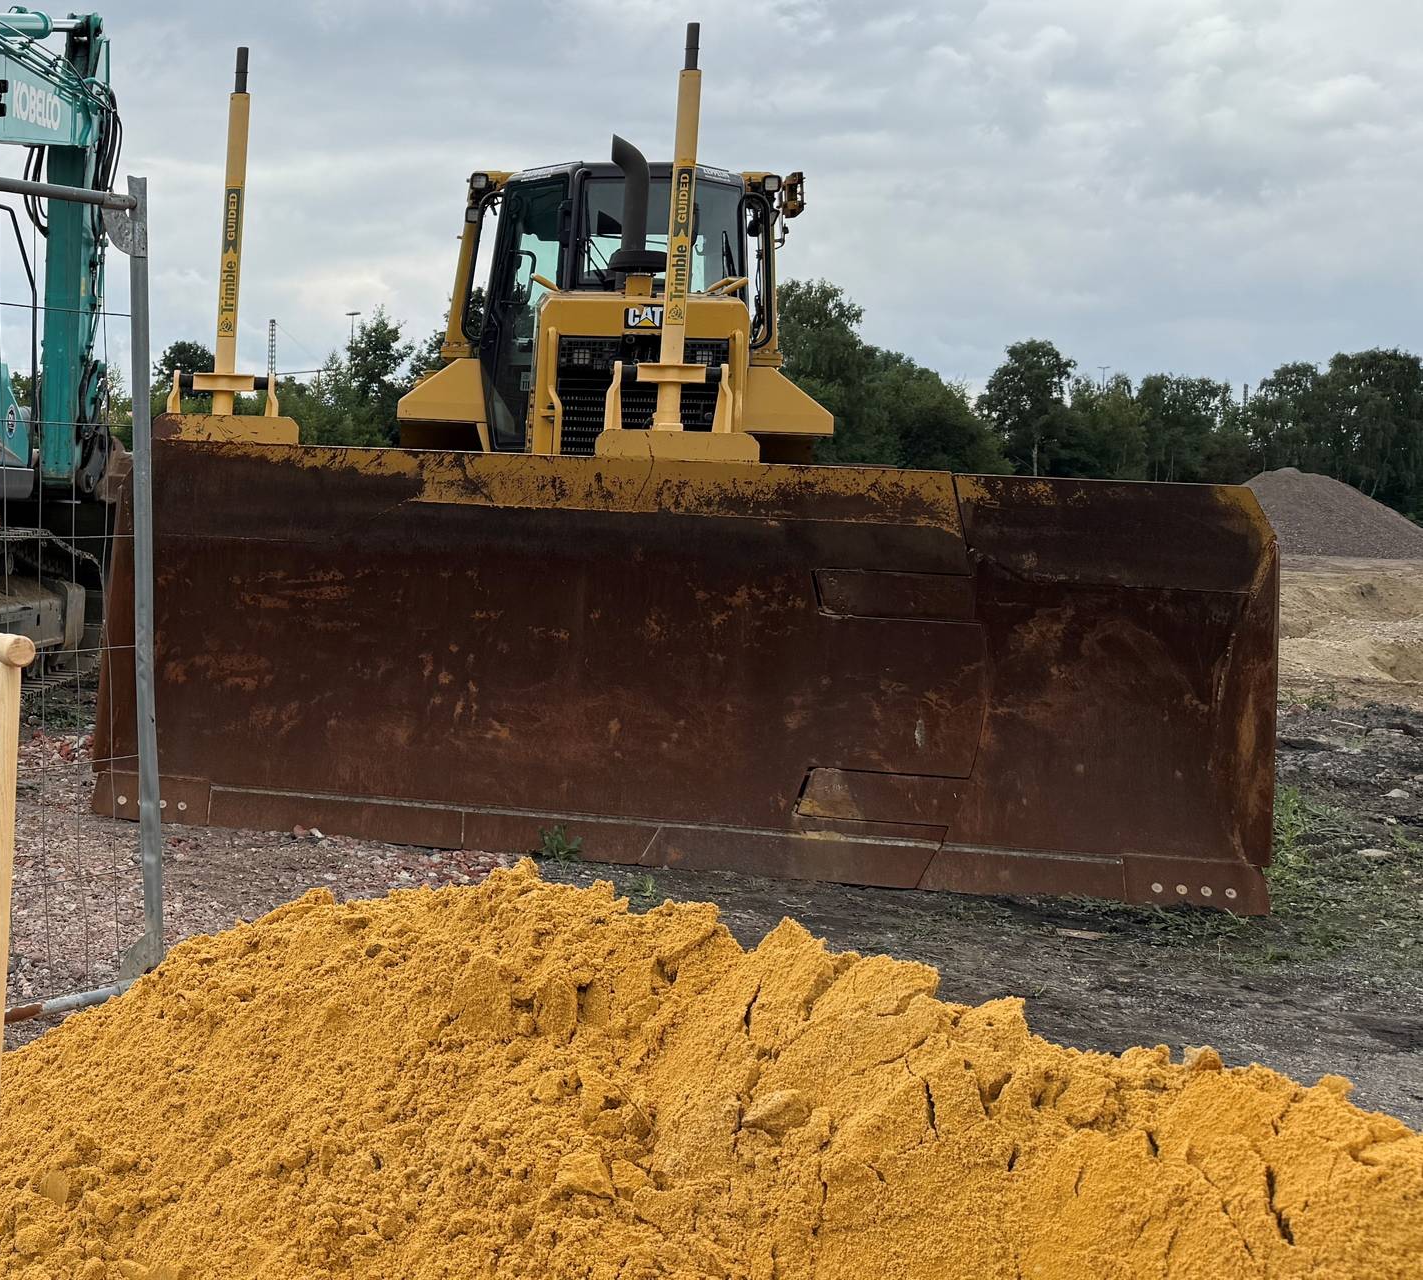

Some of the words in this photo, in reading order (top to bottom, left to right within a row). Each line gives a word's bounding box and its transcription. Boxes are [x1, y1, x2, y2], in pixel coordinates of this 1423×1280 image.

[12, 80, 61, 130] KOBELCO
[226, 192, 238, 241] GUIDED
[677, 173, 690, 224] GUIDED
[220, 260, 237, 316] Trimble
[669, 244, 688, 302] Trimble
[627, 305, 664, 327] CAT
